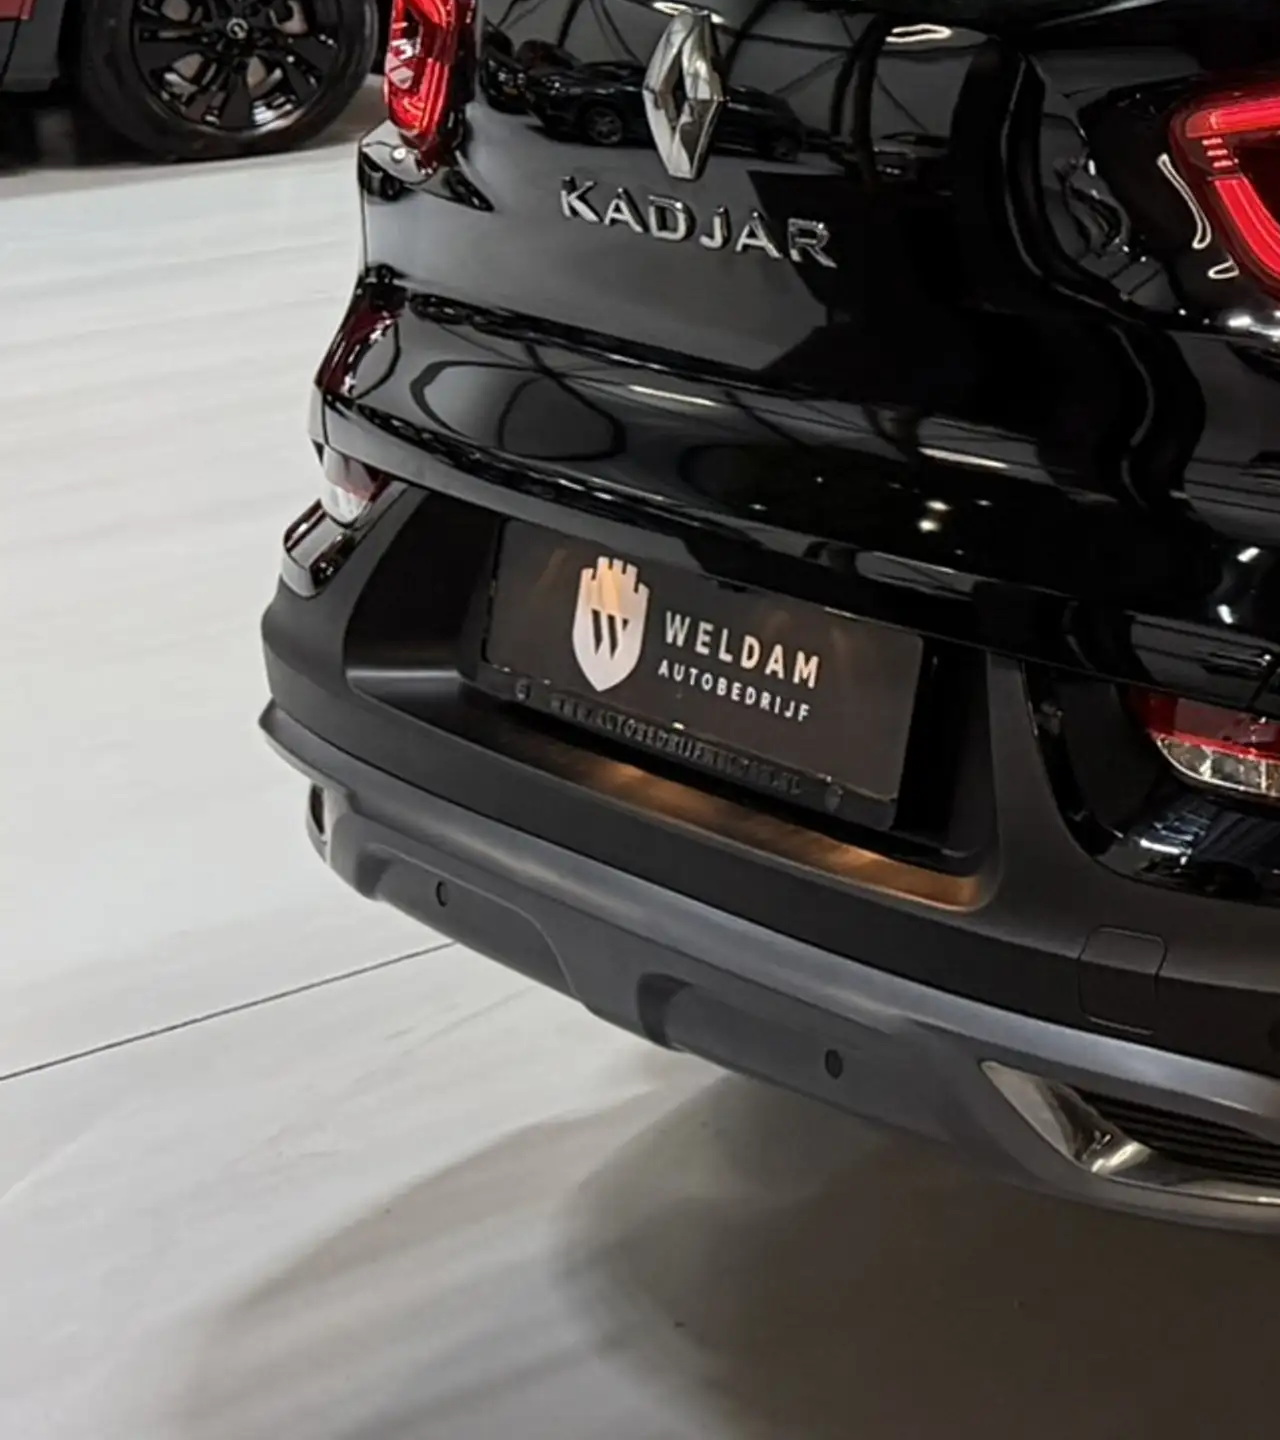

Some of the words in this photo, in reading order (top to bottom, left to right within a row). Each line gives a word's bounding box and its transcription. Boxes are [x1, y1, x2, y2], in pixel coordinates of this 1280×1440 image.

[559, 175, 838, 269] KADJAR
[664, 610, 820, 690] WELDAM
[657, 659, 811, 722] AUTOBEDRIJF
